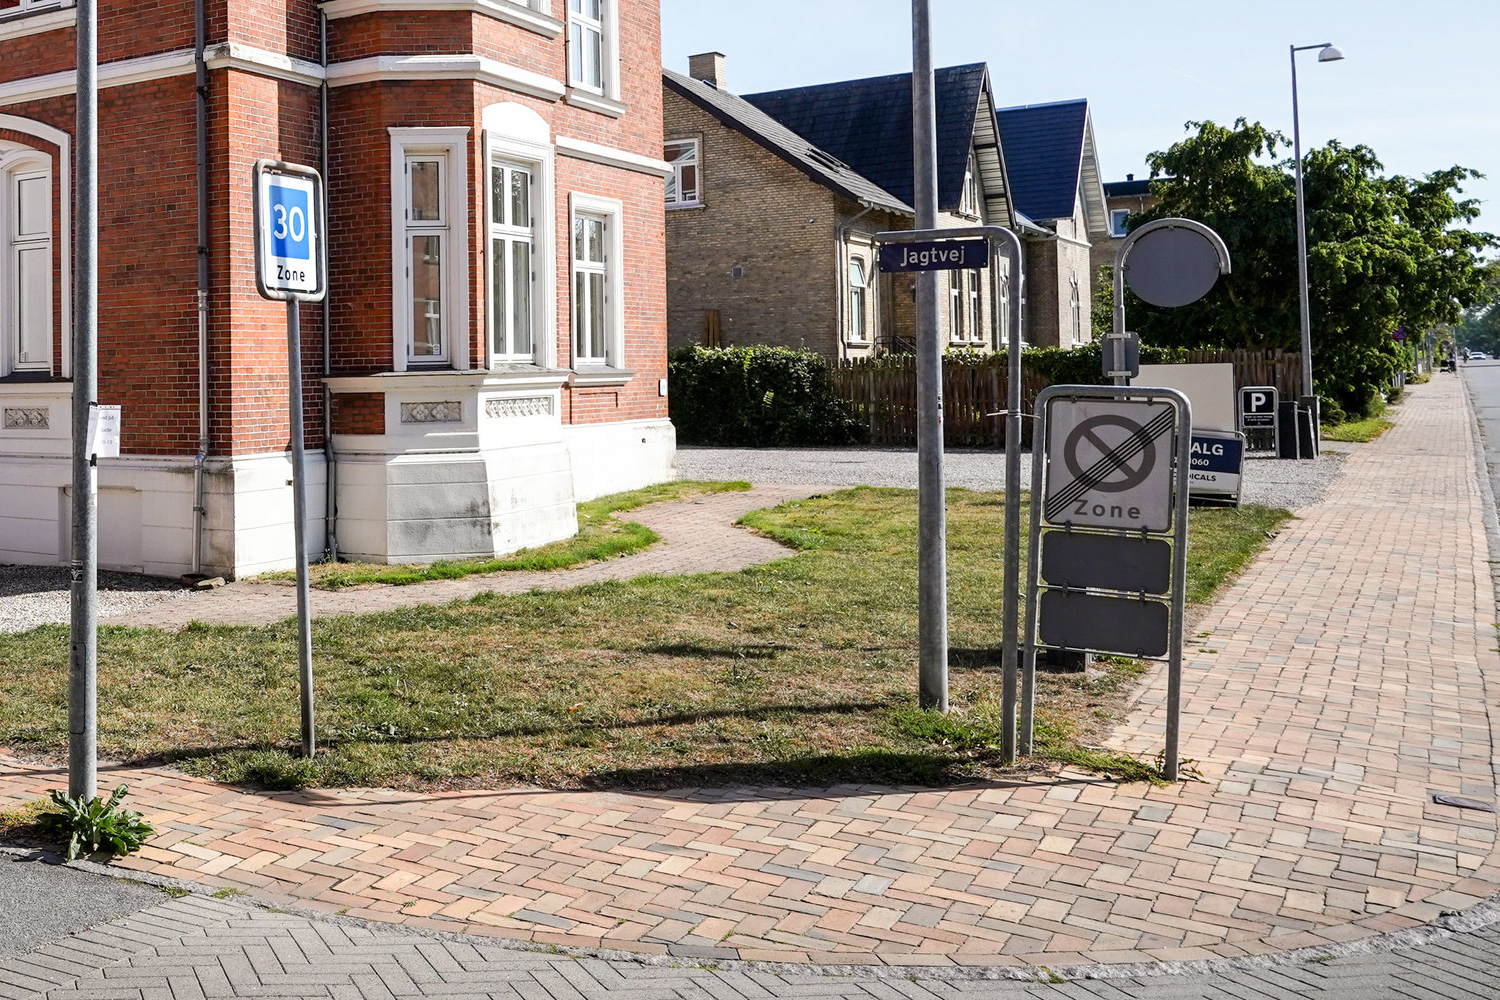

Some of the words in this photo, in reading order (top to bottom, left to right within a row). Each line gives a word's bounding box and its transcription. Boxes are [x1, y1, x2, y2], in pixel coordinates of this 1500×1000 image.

[273, 204, 305, 242] 30
[900, 246, 965, 266] Jagtvej
[277, 265, 305, 281] Zone
[1251, 393, 1266, 412] P
[1190, 442, 1224, 456] ALG
[1074, 500, 1140, 519] Zone
